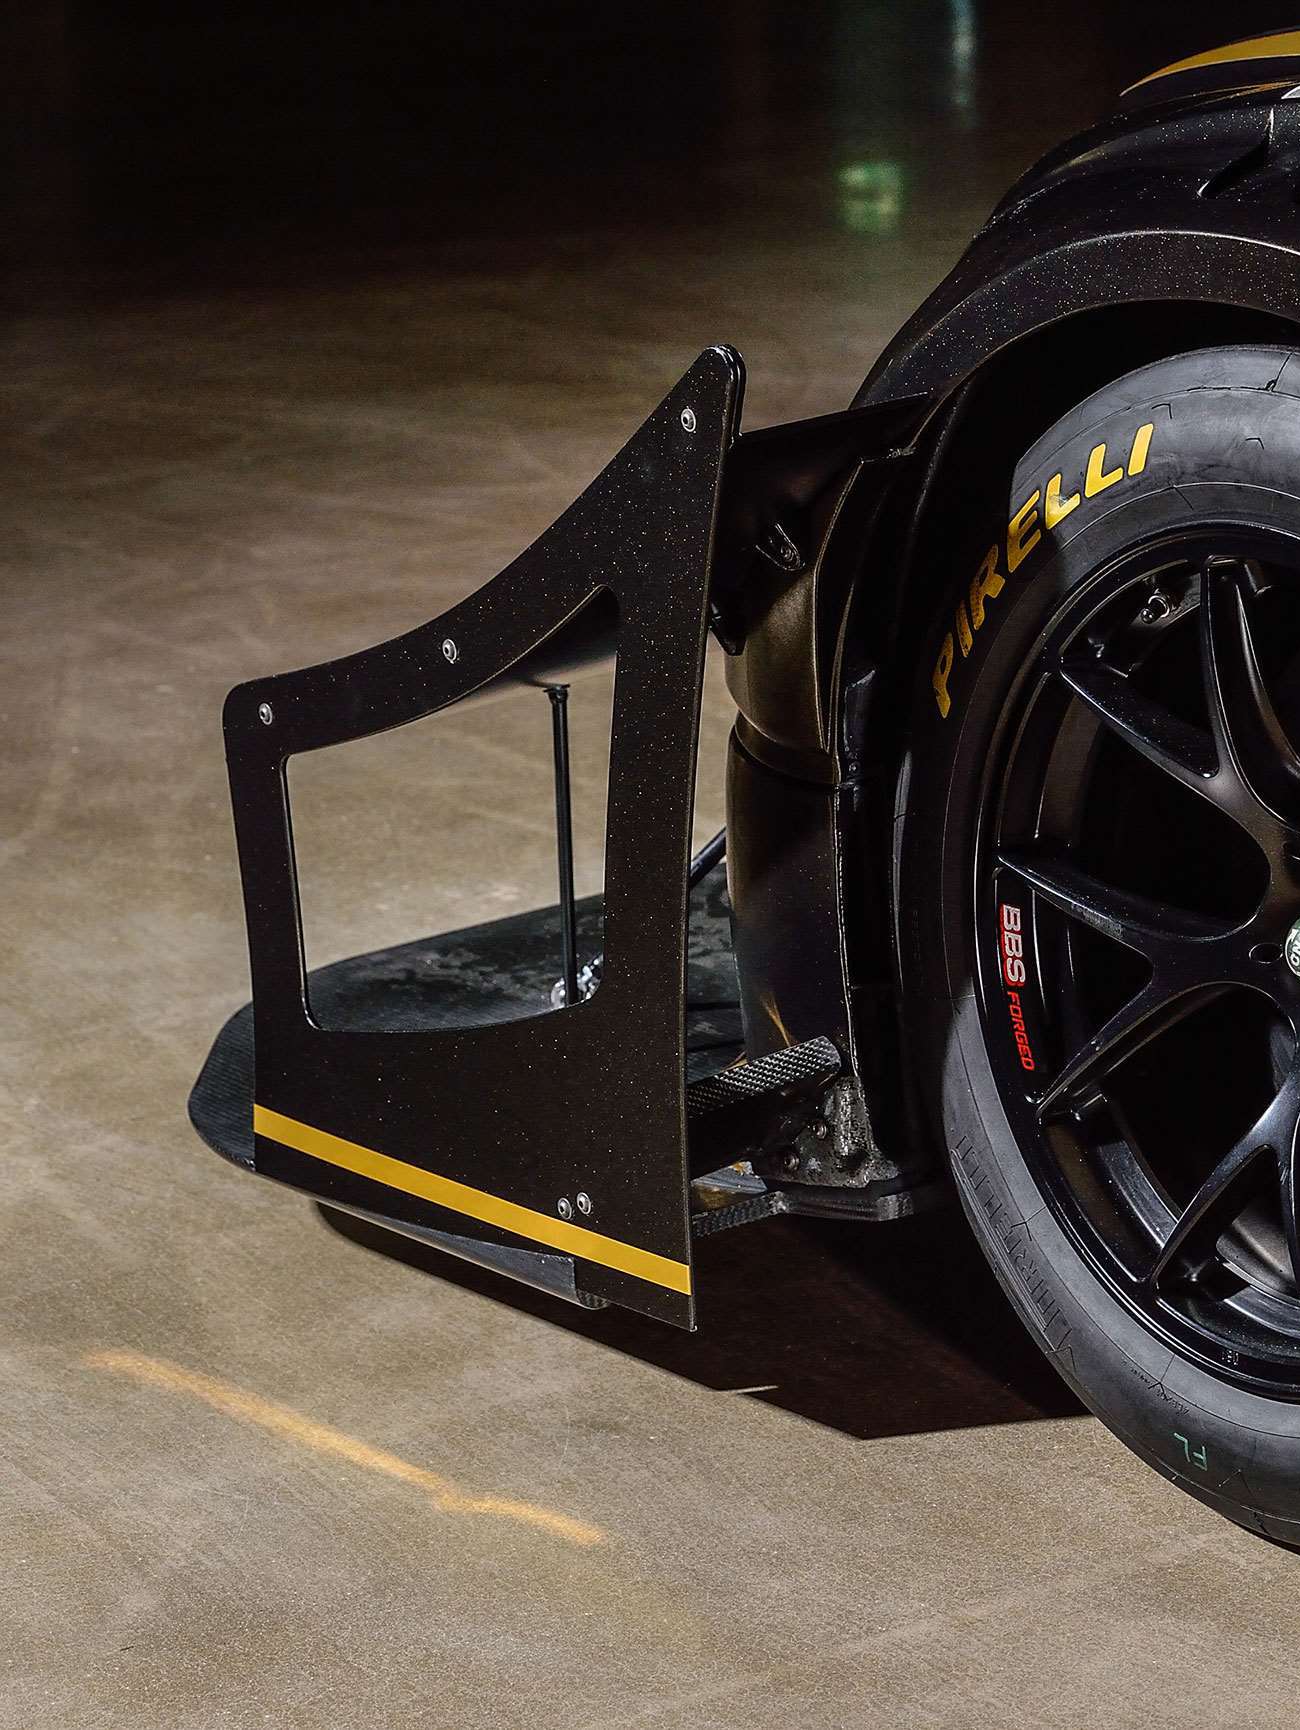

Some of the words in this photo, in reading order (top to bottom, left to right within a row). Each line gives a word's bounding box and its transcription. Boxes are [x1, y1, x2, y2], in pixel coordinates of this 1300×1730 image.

[932, 423, 1154, 719] PIRELLI
[1000, 903, 1027, 987] BBS
[1007, 991, 1035, 1071] FORGED
[1173, 1432, 1208, 1471] FL
